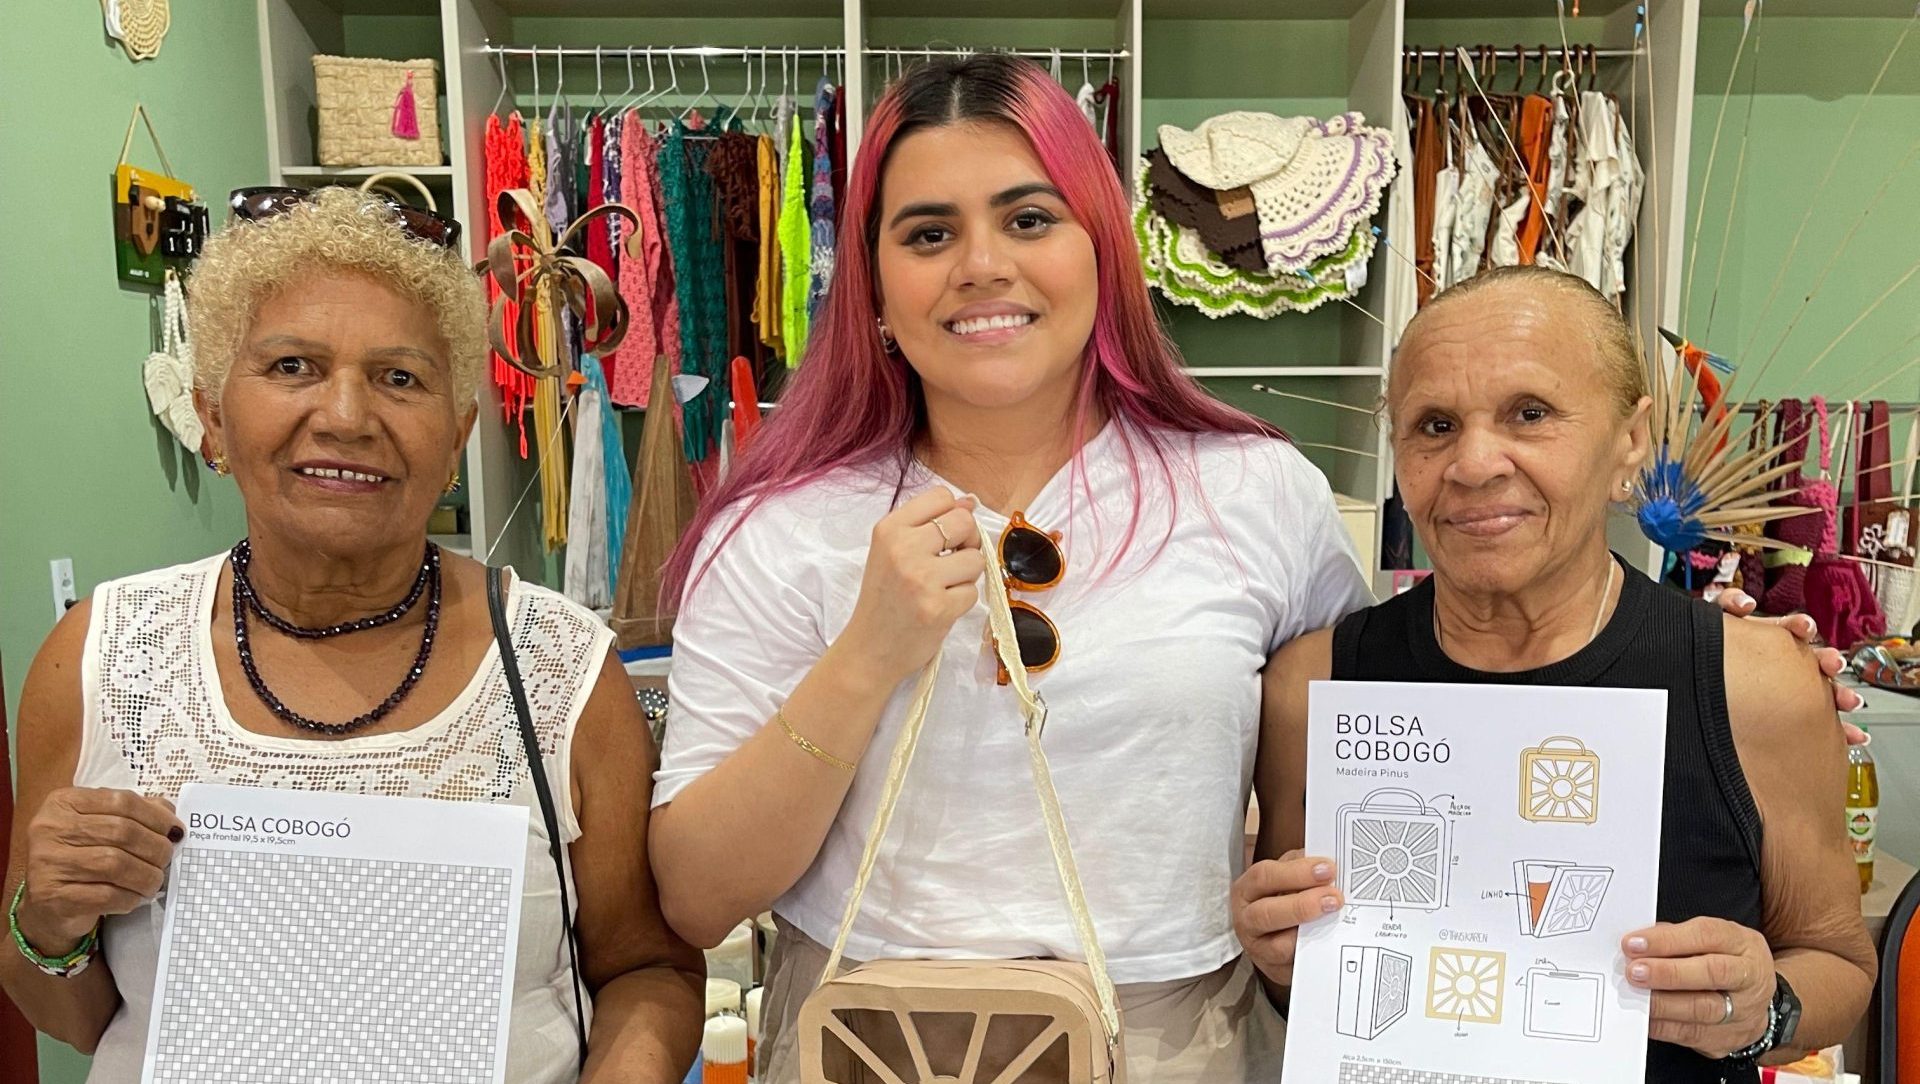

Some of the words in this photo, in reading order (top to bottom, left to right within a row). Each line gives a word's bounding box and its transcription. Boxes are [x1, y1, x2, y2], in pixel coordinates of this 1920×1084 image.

[1336, 714, 1424, 736] BOLSA
[1335, 738, 1451, 763] COBOGÓ
[1336, 767, 1378, 777] Madeira
[1380, 768, 1409, 778] Pinus
[189, 812, 257, 832] BOLSA
[262, 817, 351, 838] COBOGÓ
[189, 831, 211, 840] Peça
[213, 833, 241, 842] frontal
[243, 834, 259, 843] 19,5
[266, 836, 296, 845] 19,5cm
[1481, 889, 1504, 900] LINHO
[1382, 923, 1402, 931] RENDA
